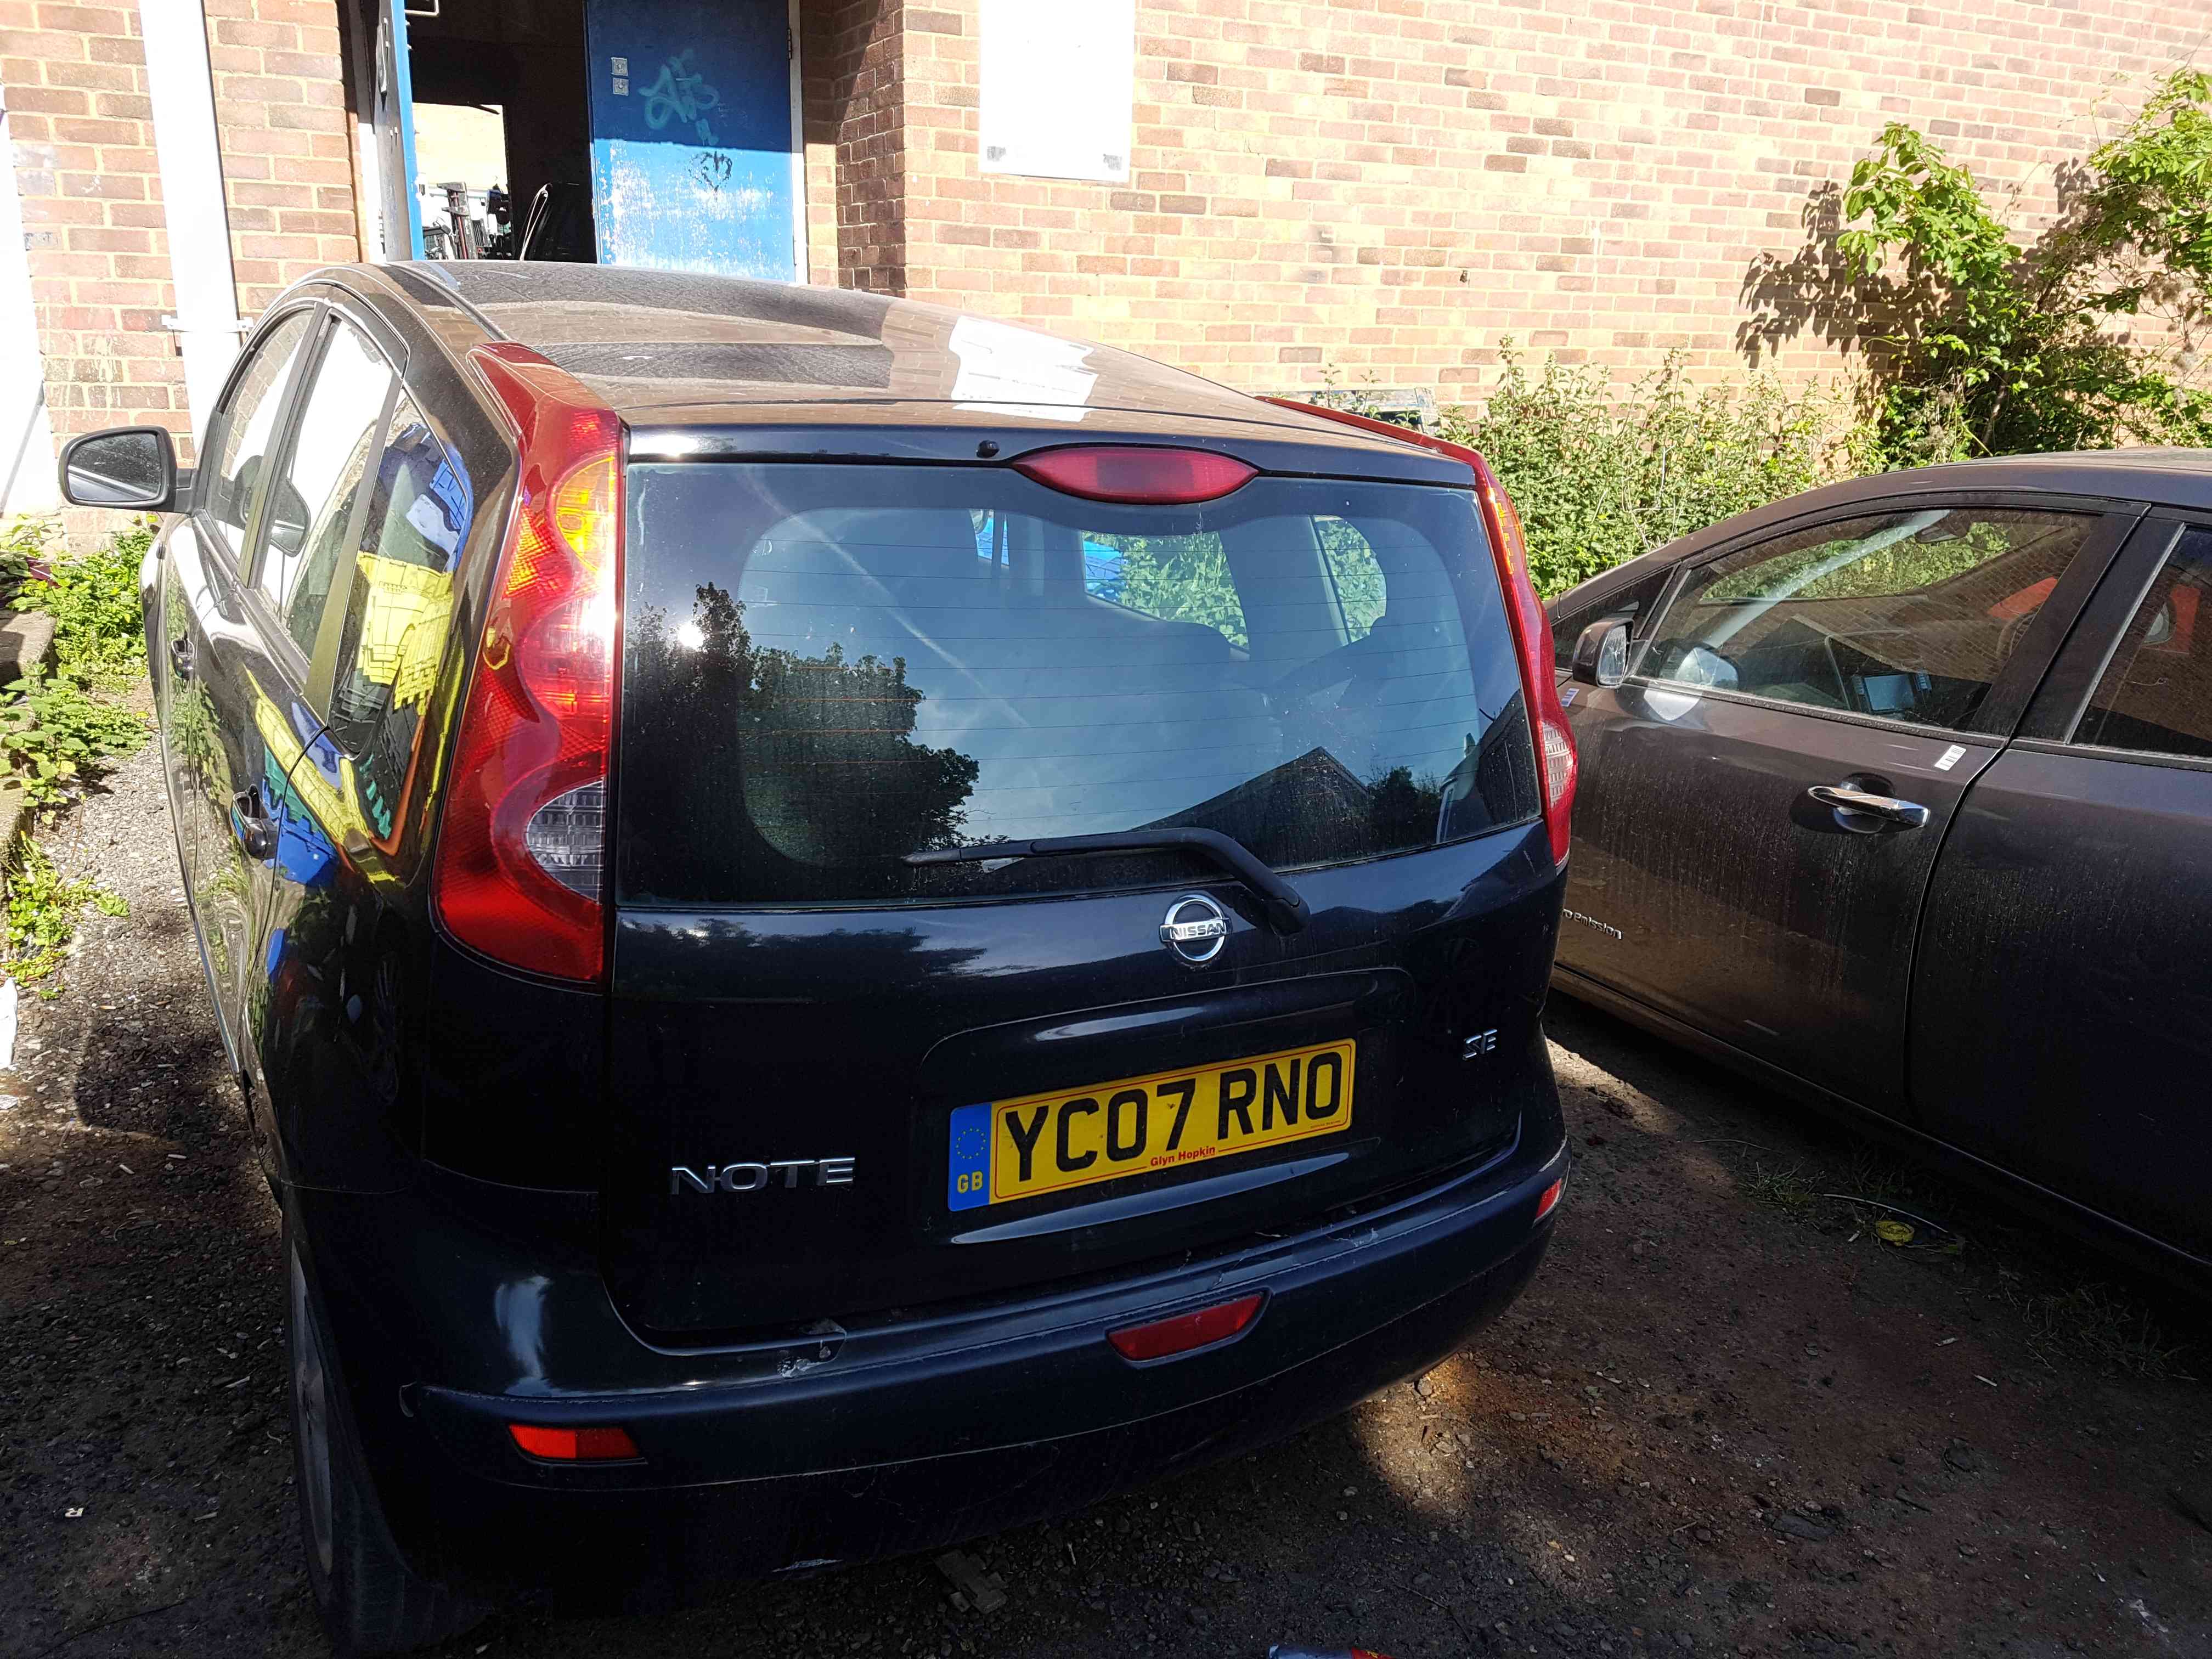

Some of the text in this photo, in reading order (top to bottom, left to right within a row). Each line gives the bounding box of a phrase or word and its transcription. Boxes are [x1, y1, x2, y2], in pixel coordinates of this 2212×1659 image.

[1170, 923, 1226, 939] NISSAN
[1463, 1028, 1498, 1060] SE
[1005, 1052, 1342, 1182] YC07 RNO
[1150, 1146, 1216, 1166] Glyn Hopkin
[672, 1158, 855, 1195] NOTE
[957, 1171, 984, 1194] GB
